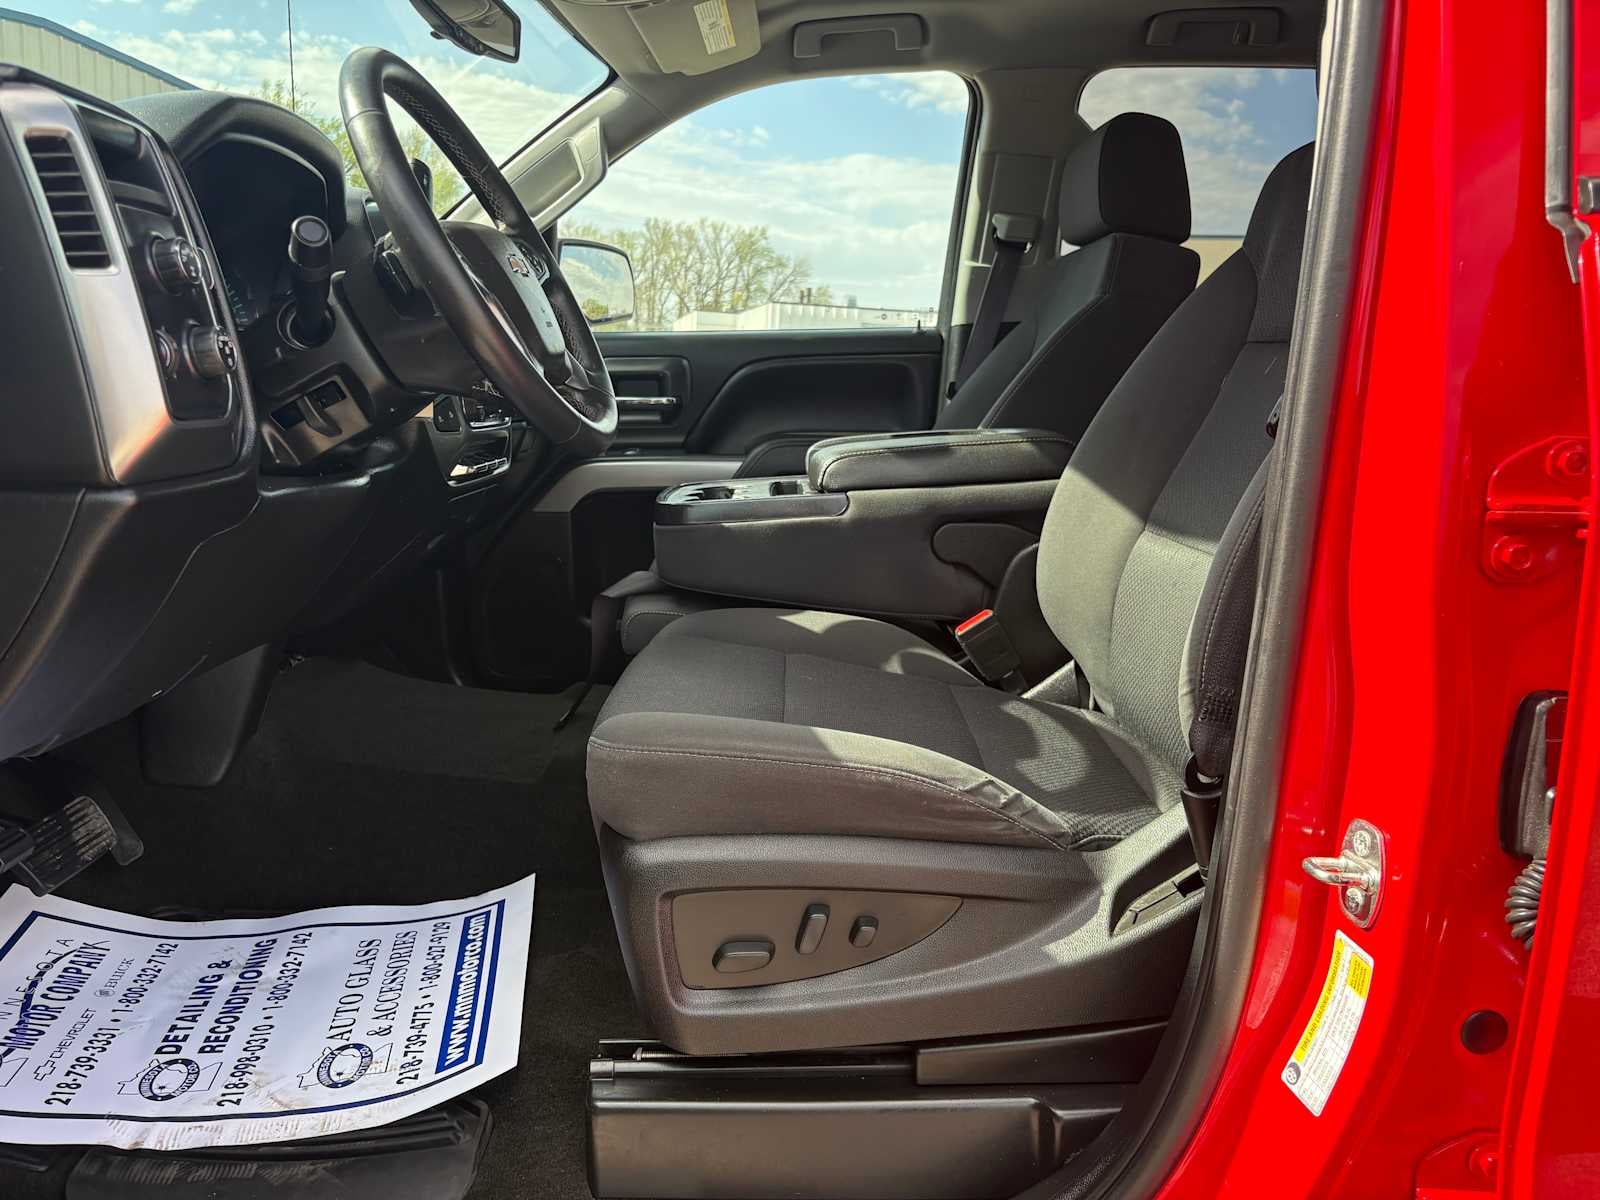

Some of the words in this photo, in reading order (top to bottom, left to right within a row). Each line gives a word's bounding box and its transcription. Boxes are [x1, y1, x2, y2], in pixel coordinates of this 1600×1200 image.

[0, 1004, 66, 1050] MOTOR
[40, 942, 111, 1002] COMPANY
[104, 958, 135, 988] BUICK
[154, 973, 224, 1055] DETAILING
[208, 959, 233, 970] &
[197, 938, 279, 1054] RECONDITIONING
[344, 938, 382, 989] GLASS
[371, 930, 418, 1021] ACCESSORIES
[396, 1002, 435, 1085] 218-739-4775
[418, 921, 451, 990] 1-800-627-9129
[445, 914, 487, 1066] www.mnmotorco.com
[44, 1027, 121, 1106] 218-739-3331
[111, 943, 179, 1013] 1-800-332-7142
[49, 1008, 96, 1058] CHEVROLET
[216, 1024, 275, 1106] 218-998-0310
[262, 932, 313, 1010] 1-800-332-7142
[326, 993, 364, 1041] AUTO
[366, 1025, 393, 1037] &
